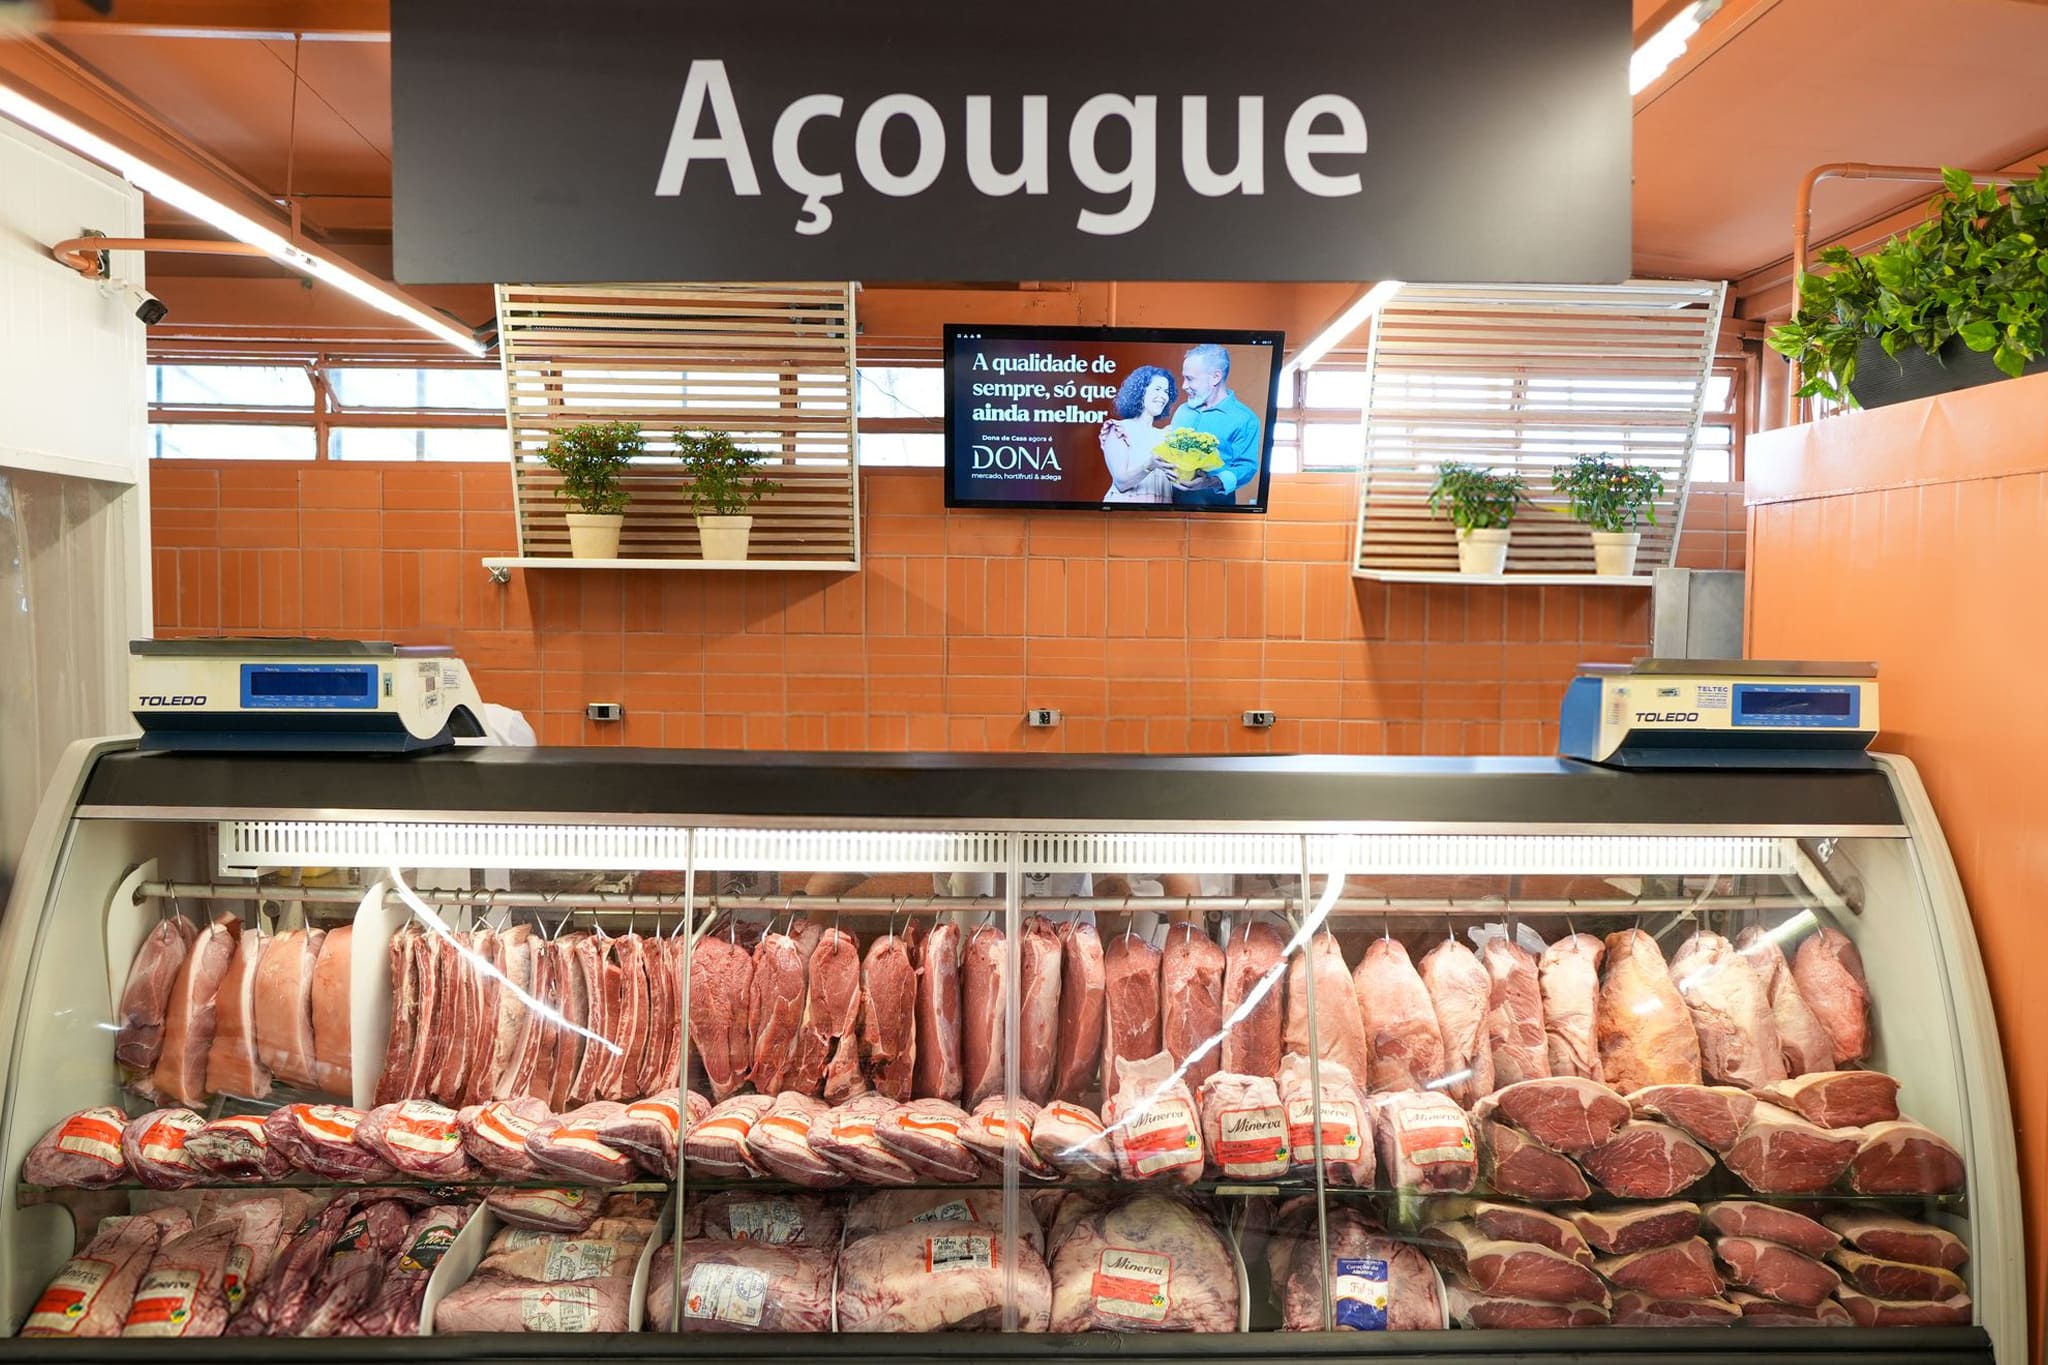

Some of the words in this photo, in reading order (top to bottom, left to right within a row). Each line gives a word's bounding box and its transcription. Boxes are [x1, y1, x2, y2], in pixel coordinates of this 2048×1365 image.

[655, 59, 1368, 235] Açougue
[972, 353, 989, 371] A
[992, 353, 1088, 376] qualidade
[1091, 355, 1116, 373] de
[972, 382, 1051, 401] sempre,
[1053, 380, 1077, 398] só
[1079, 385, 1117, 403] que
[972, 403, 1031, 421] ainda
[1033, 405, 1109, 424] melhor
[971, 445, 1062, 471] DONA
[139, 696, 208, 707] TOLEDO
[1635, 712, 1699, 723] TOLEDO
[1132, 1111, 1184, 1129] Minerva
[1228, 1118, 1281, 1134] Minerva
[1107, 1256, 1163, 1275] Minerva
